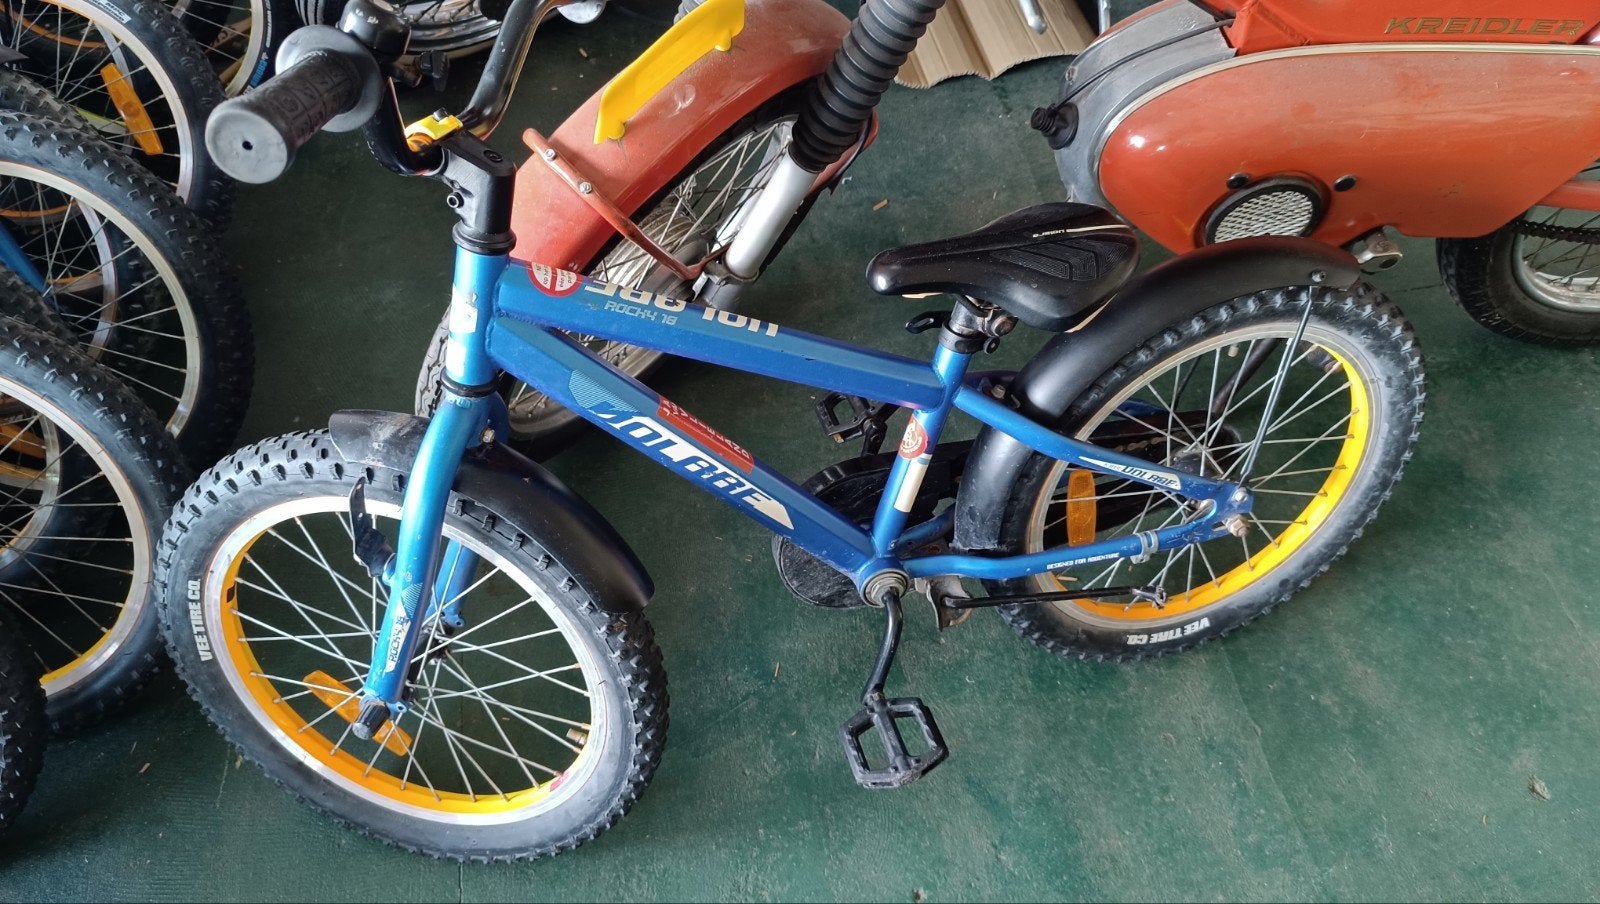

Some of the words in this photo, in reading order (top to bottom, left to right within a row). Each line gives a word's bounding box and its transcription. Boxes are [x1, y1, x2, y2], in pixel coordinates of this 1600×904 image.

[1384, 17, 1584, 36] KREIDLER
[604, 300, 657, 322] ROCKY
[661, 312, 679, 326] 18
[1046, 560, 1074, 570] DESIGNED
[1074, 557, 1087, 565] FOR
[1087, 552, 1120, 562] ADVENTURE
[187, 578, 201, 600] CO.
[188, 602, 206, 635] TIRE
[1183, 616, 1211, 635] VEE
[1126, 634, 1148, 645] CO.
[1149, 627, 1183, 644] TIRE
[194, 634, 213, 661] VEE
